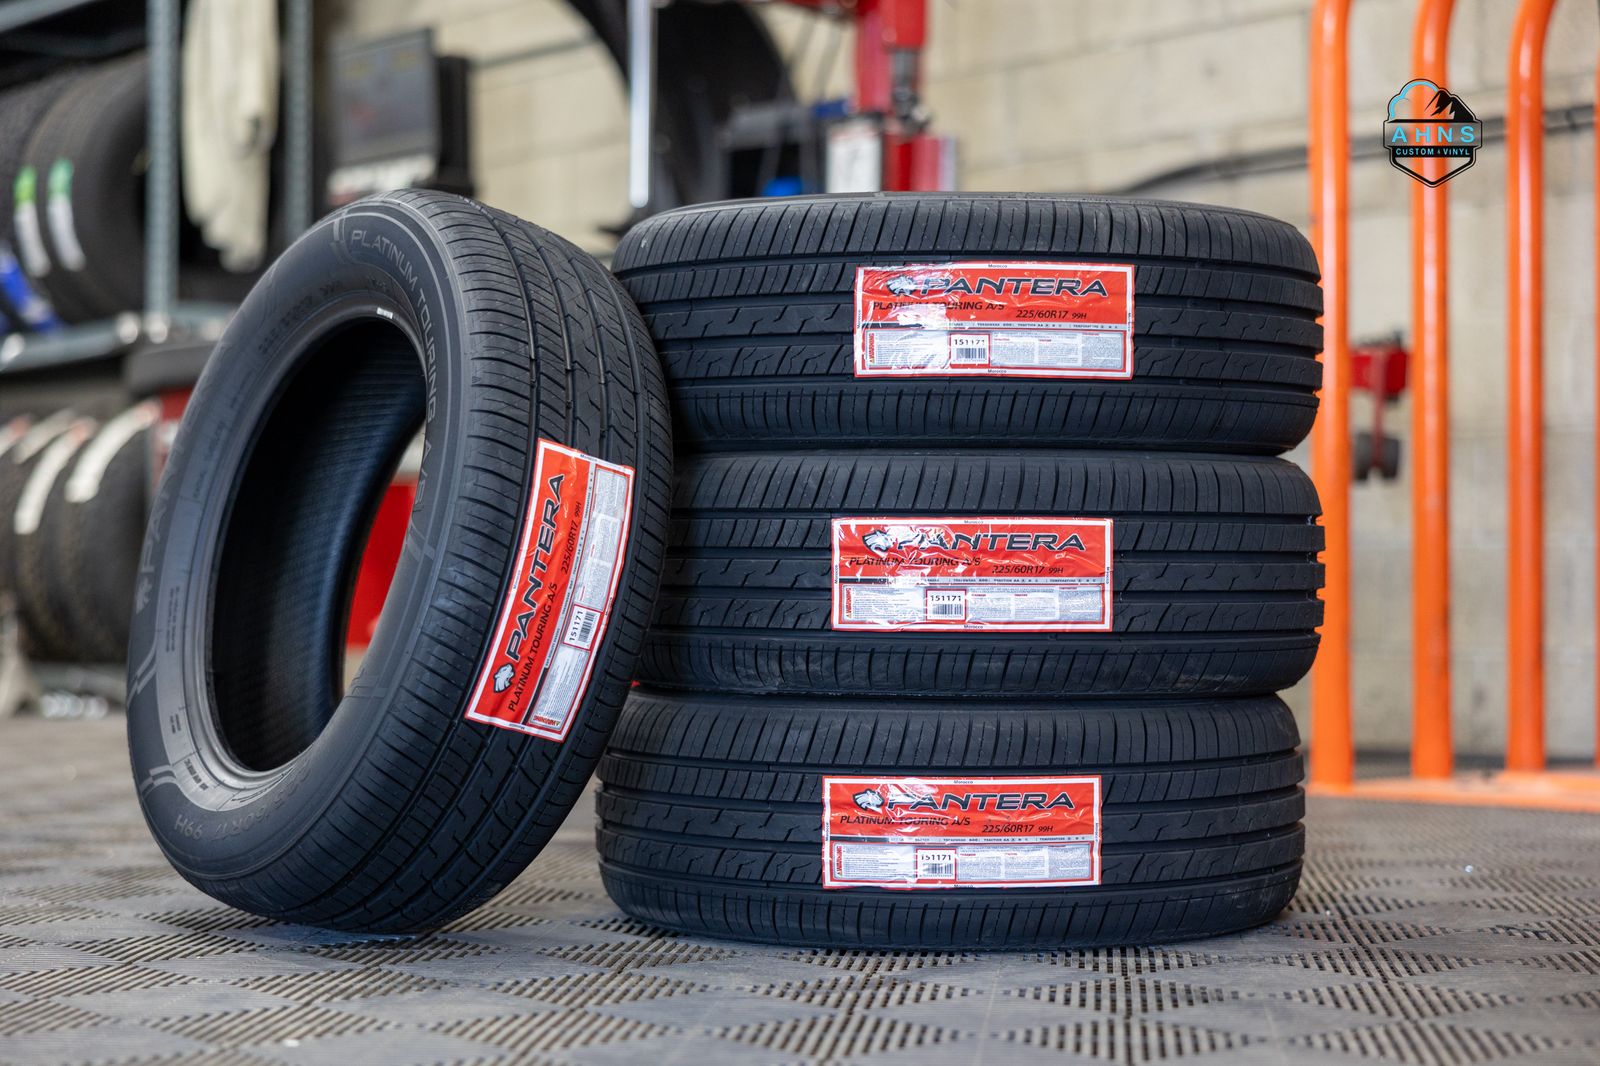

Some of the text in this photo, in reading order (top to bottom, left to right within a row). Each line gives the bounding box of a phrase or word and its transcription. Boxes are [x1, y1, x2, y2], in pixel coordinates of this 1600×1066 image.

[920, 276, 1107, 297] PANTERA
[985, 302, 1006, 311] A/S
[1015, 309, 1069, 319] 225/60R17
[351, 229, 418, 292] PLATINUM
[417, 288, 437, 423] TOURING
[561, 501, 582, 575] 225/60R17 99H
[849, 556, 905, 566] PLATINUM
[505, 474, 565, 662] PANTERA
[992, 564, 1045, 574] 225/60R17
[930, 594, 962, 602] 151171
[569, 610, 584, 642] 151171
[508, 656, 534, 712] PLATINUM
[530, 604, 552, 658] TOURING
[547, 582, 558, 603] A/S
[839, 815, 971, 826] PLATINUM TOURING A/S
[981, 824, 1054, 833] 225/60R17 99H
